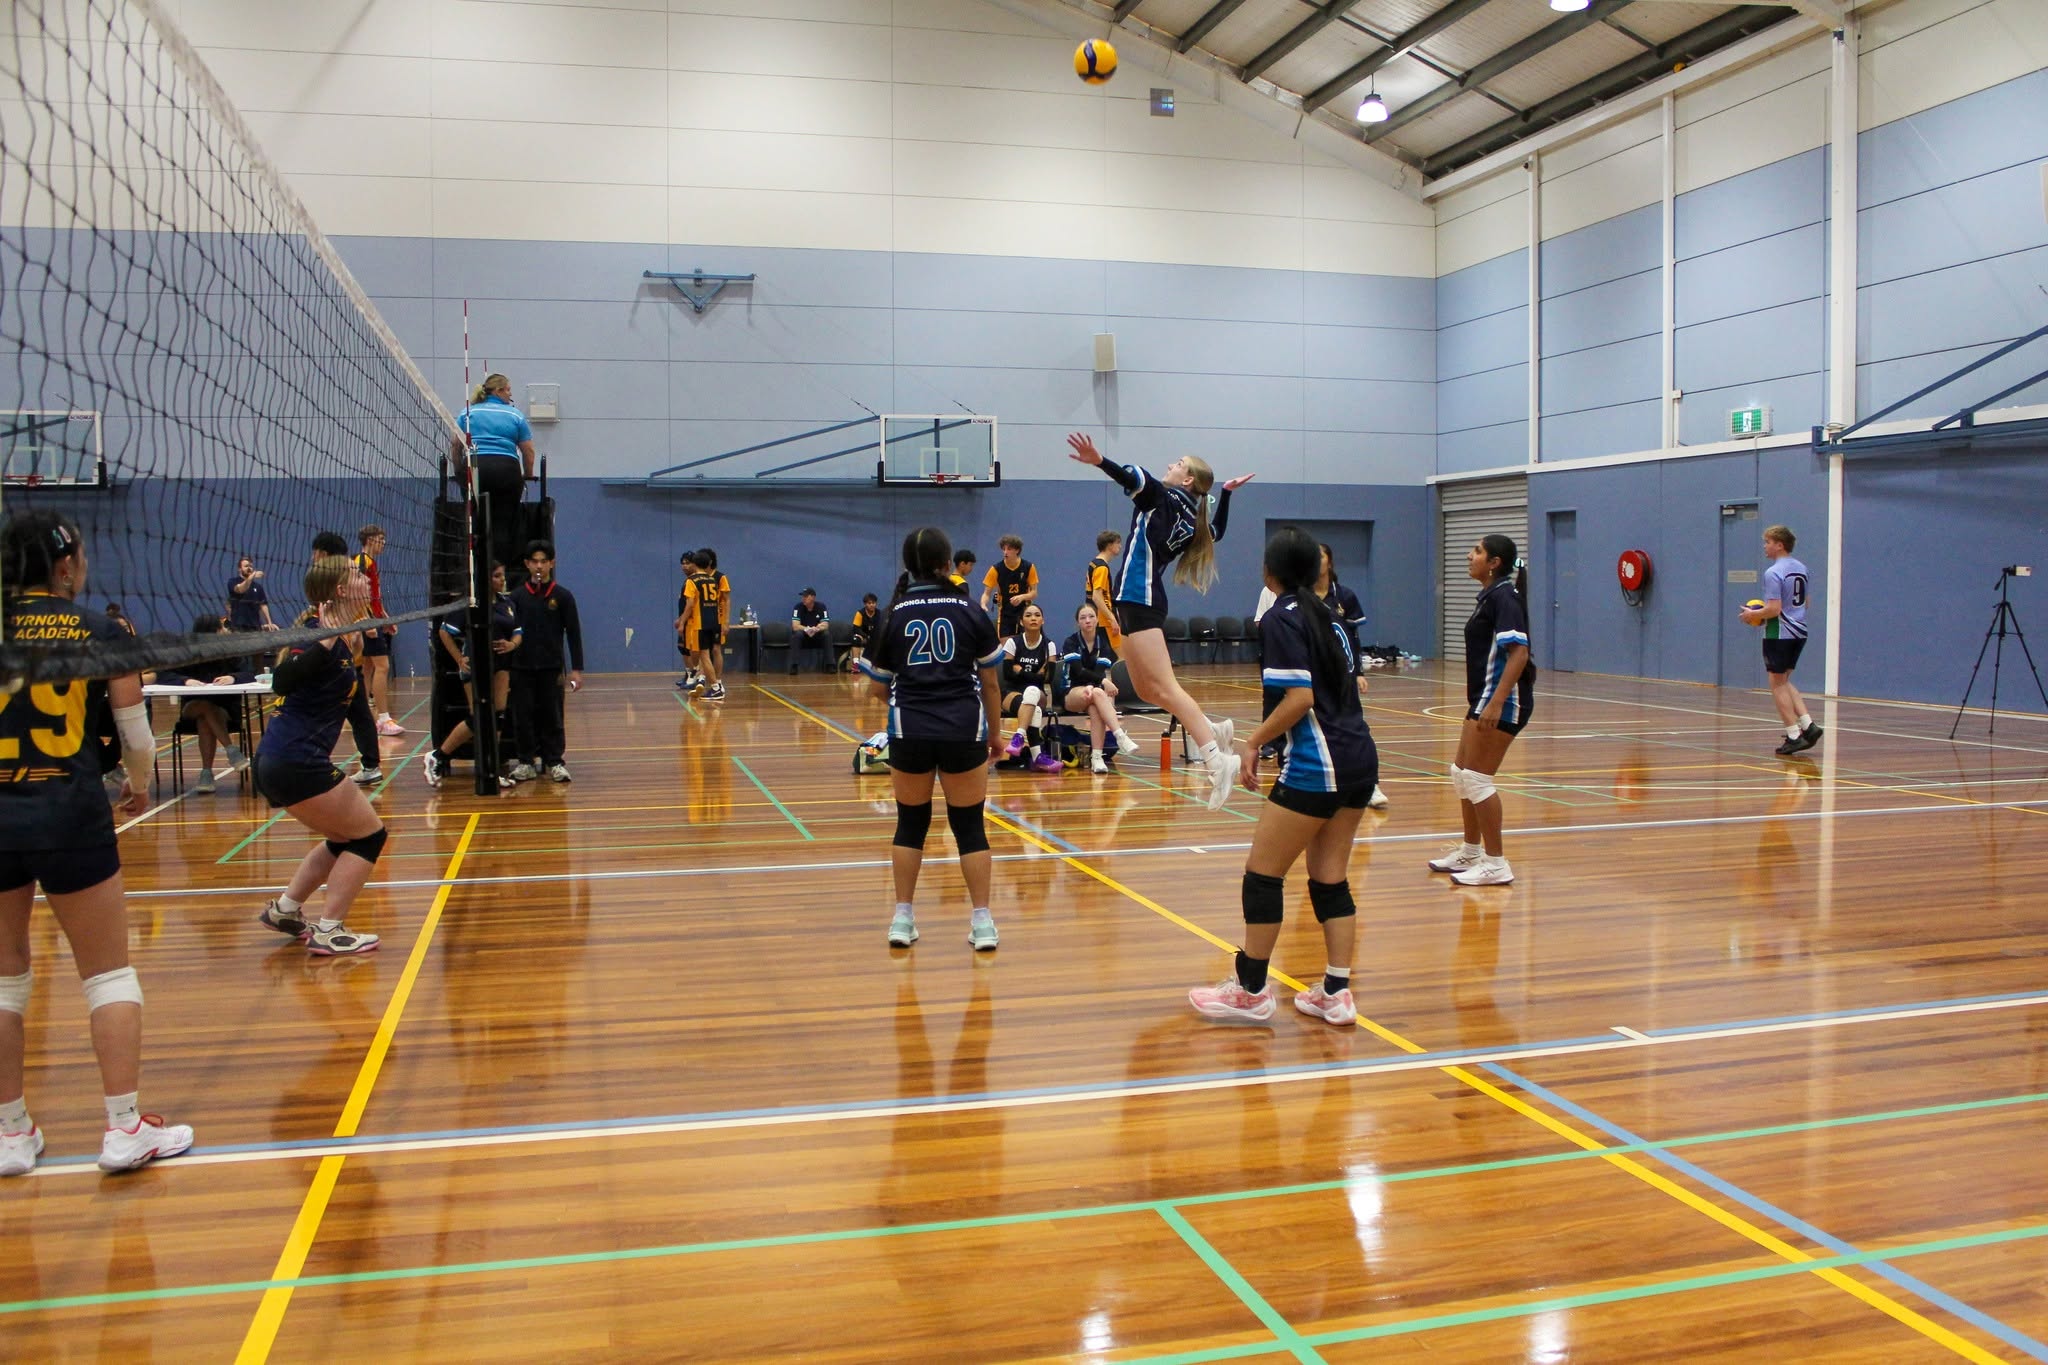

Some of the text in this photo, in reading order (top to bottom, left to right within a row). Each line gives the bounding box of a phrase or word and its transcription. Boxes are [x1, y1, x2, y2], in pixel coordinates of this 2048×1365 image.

[702, 583, 718, 601] 15
[1008, 583, 1020, 594] 23
[1792, 576, 1806, 607] 9
[892, 599, 927, 612] ODONGA
[14, 613, 81, 626] YRNONG
[14, 626, 92, 640] ACADEMY
[904, 617, 956, 666] 20
